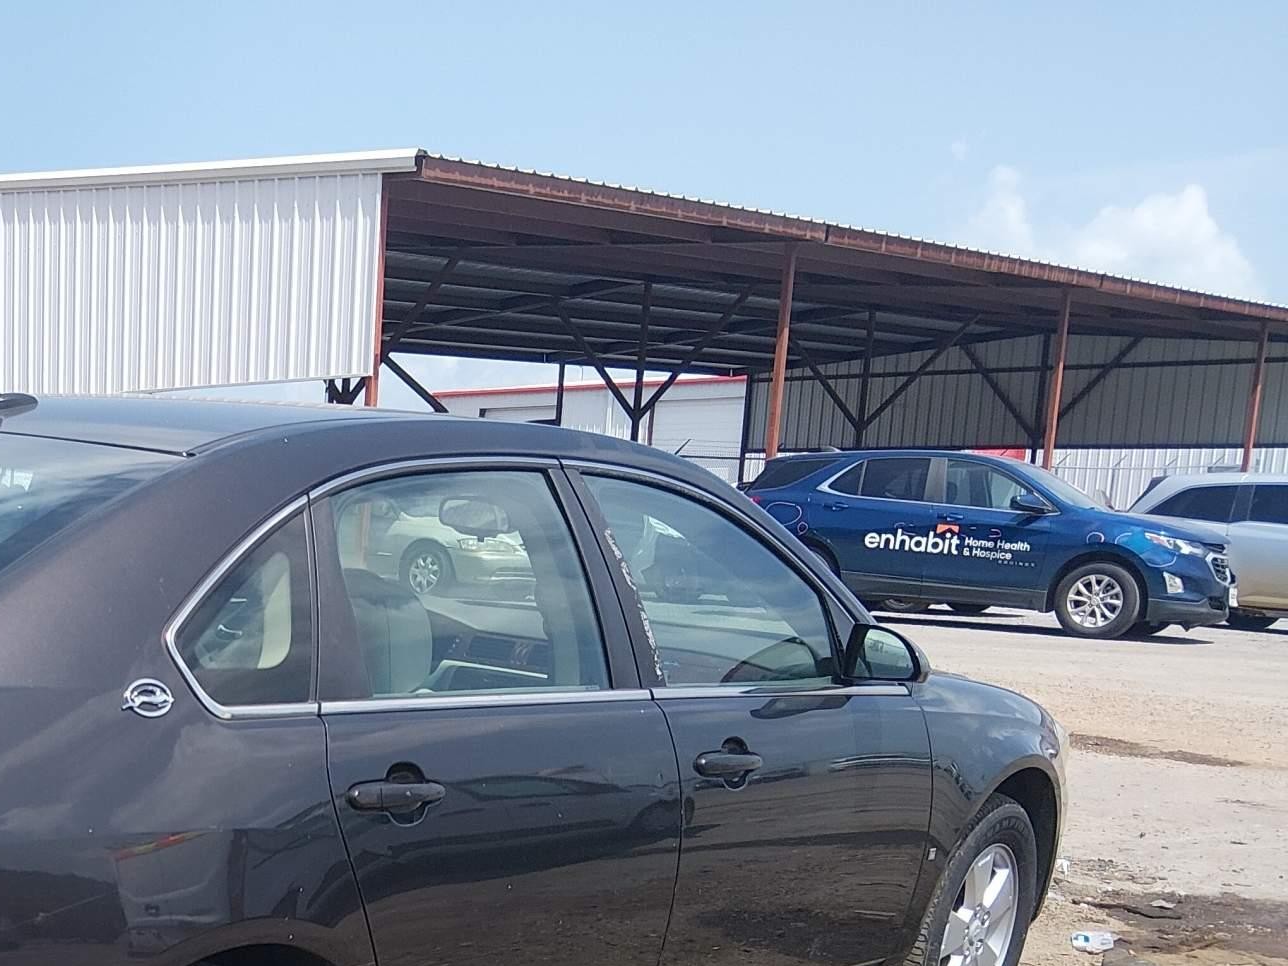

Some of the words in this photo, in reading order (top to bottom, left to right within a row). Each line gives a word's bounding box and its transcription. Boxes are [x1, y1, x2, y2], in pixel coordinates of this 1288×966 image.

[864, 529, 960, 555] enhabit
[964, 537, 996, 549] Home
[997, 539, 1031, 552] Health
[963, 547, 970, 556] &
[972, 548, 1012, 560] Hospice
